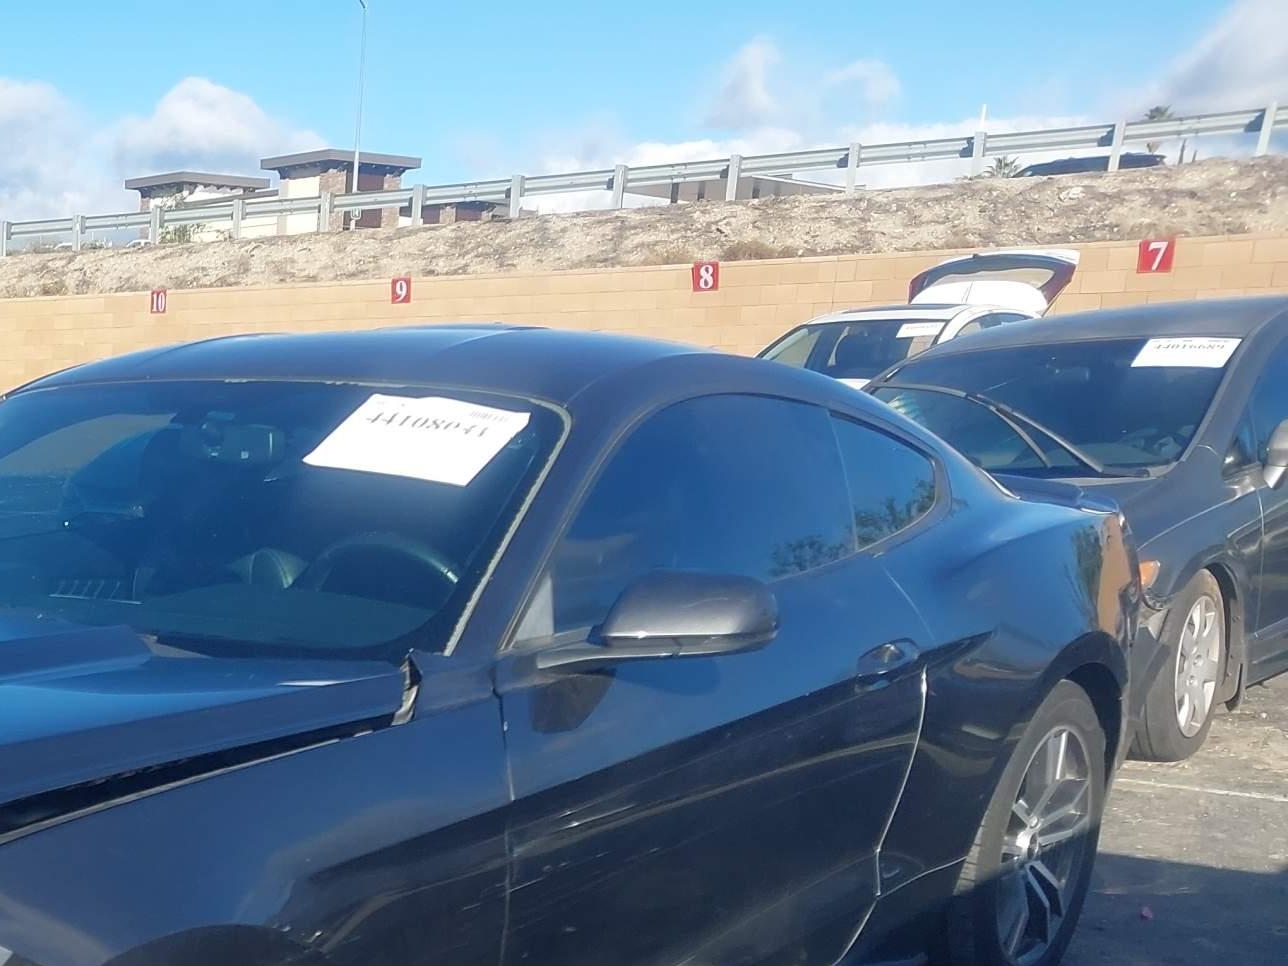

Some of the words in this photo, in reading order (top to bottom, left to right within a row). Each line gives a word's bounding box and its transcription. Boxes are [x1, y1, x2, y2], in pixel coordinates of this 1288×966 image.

[1148, 241, 1169, 271] 7
[699, 264, 714, 289] 8
[152, 291, 166, 312] 10
[395, 280, 407, 302] 9
